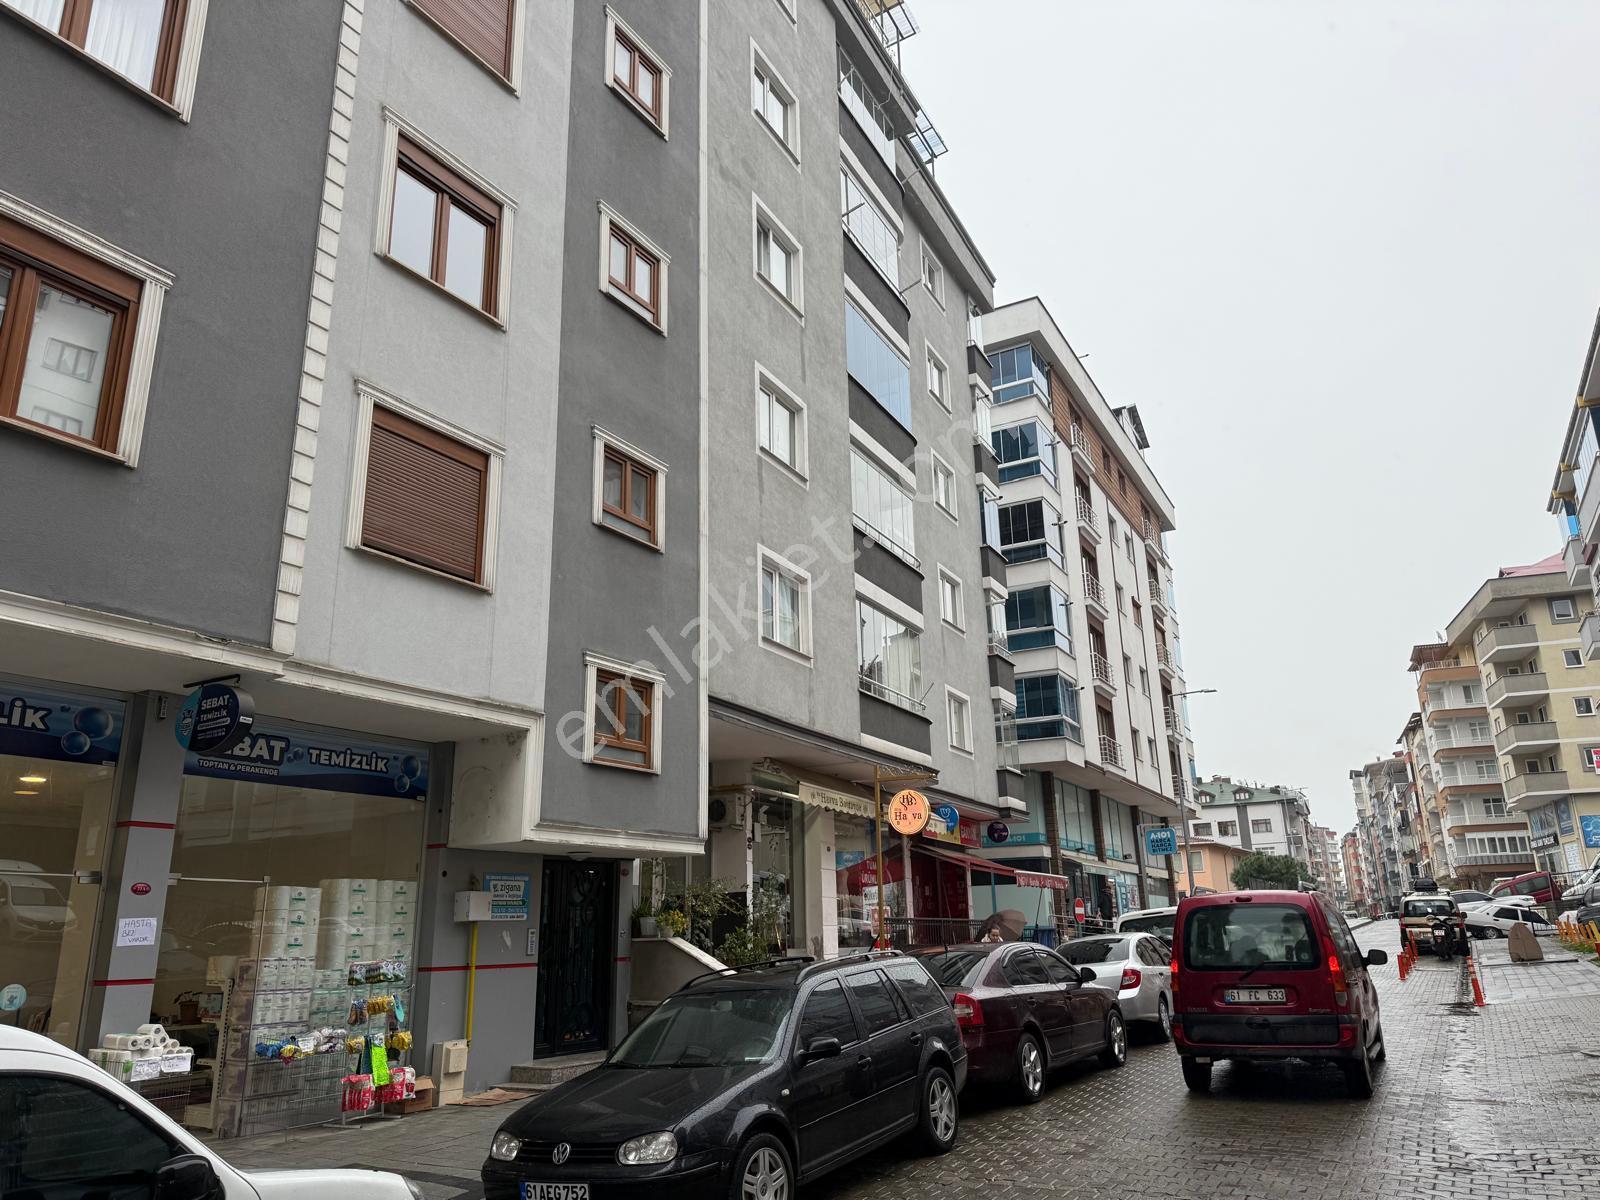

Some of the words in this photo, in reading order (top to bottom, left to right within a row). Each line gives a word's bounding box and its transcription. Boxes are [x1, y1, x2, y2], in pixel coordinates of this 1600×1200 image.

[201, 695, 230, 710] SEBAT
[200, 708, 227, 722] TEMİZLİK
[224, 736, 286, 761] BAT
[309, 749, 388, 772] TEMİZLİK
[199, 759, 229, 770] TOPTAN
[237, 765, 279, 776] PERAKENDE
[500, 882, 521, 893] zigana
[124, 919, 152, 929] HASTA
[1231, 991, 1240, 1001] 61
[1249, 990, 1260, 1001] FC
[1267, 990, 1284, 1001] 633
